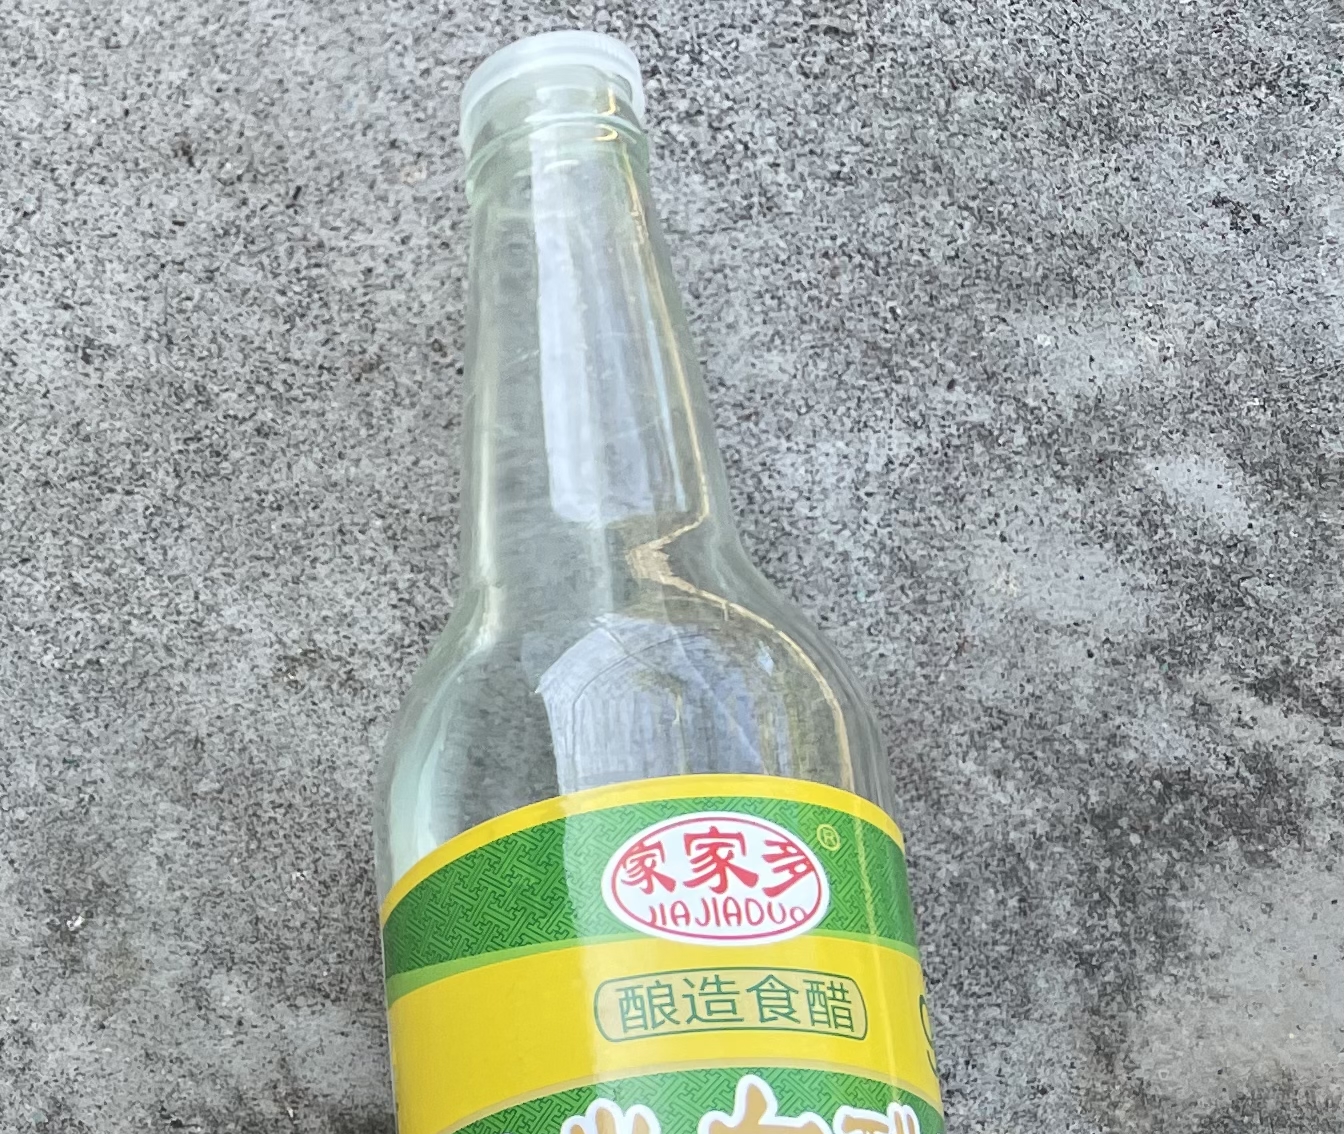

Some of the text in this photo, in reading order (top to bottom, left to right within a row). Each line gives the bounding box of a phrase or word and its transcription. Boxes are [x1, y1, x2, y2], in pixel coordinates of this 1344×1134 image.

[620, 825, 814, 898] 家家多
[647, 896, 807, 927] JIAJIADUO
[617, 973, 856, 1034] 酿造食醋
